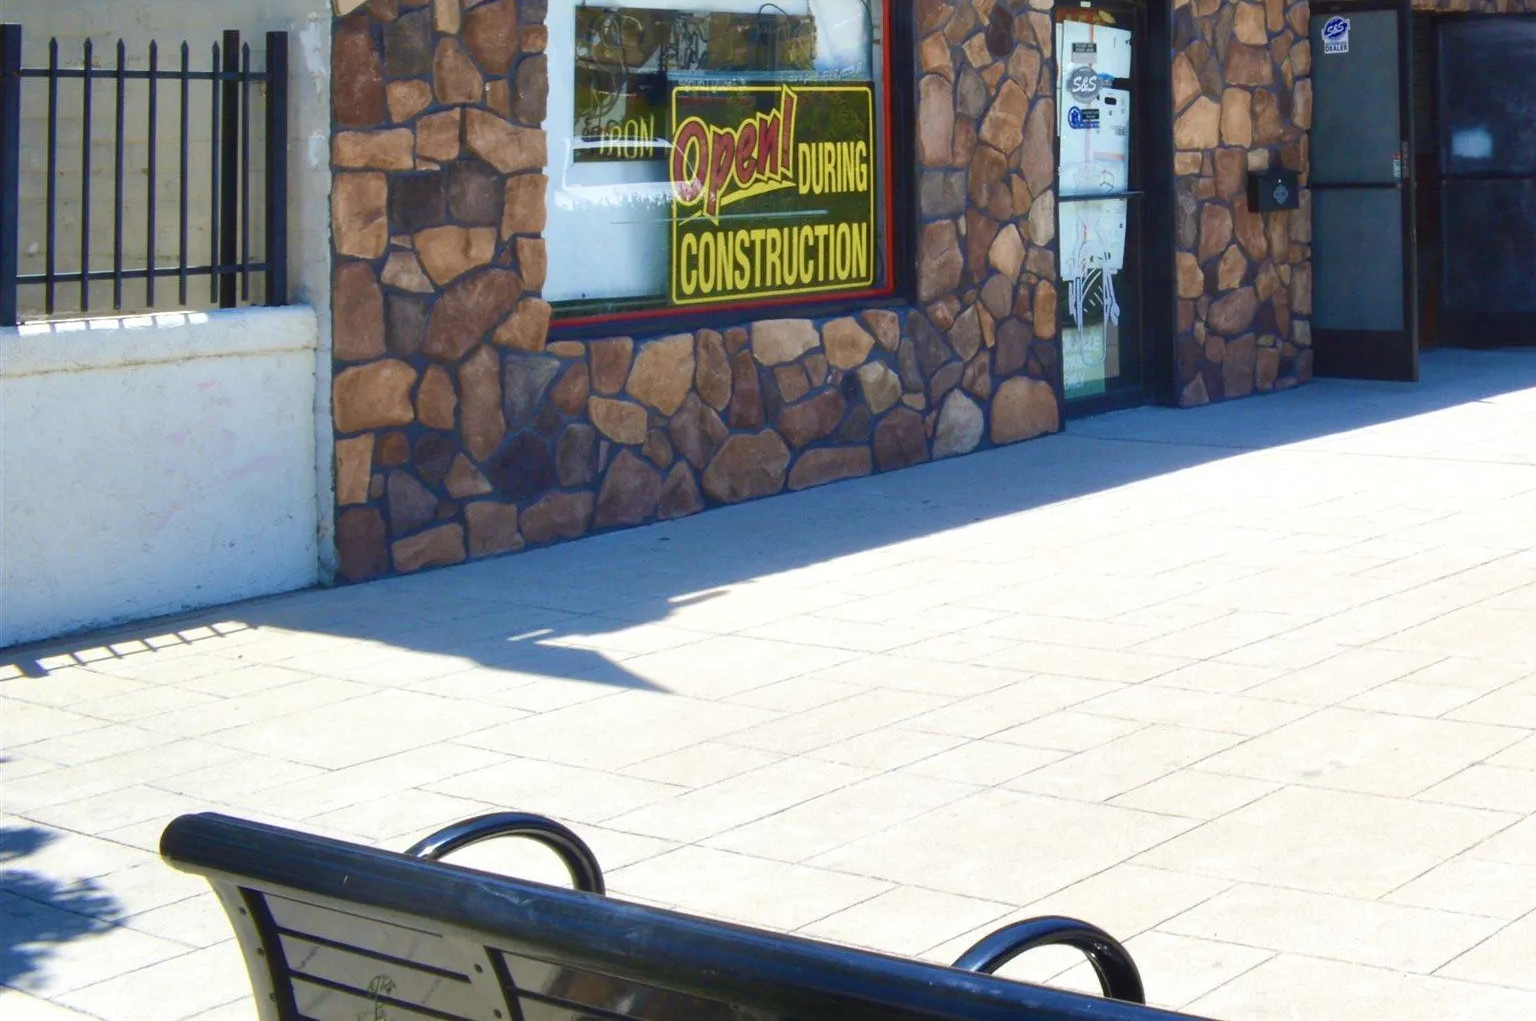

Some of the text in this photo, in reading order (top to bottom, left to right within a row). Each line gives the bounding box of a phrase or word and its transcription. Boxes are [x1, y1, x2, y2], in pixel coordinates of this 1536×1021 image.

[1072, 76, 1097, 93] S&S
[798, 141, 868, 195] DURING
[681, 223, 868, 296] CONSTRUCTION
